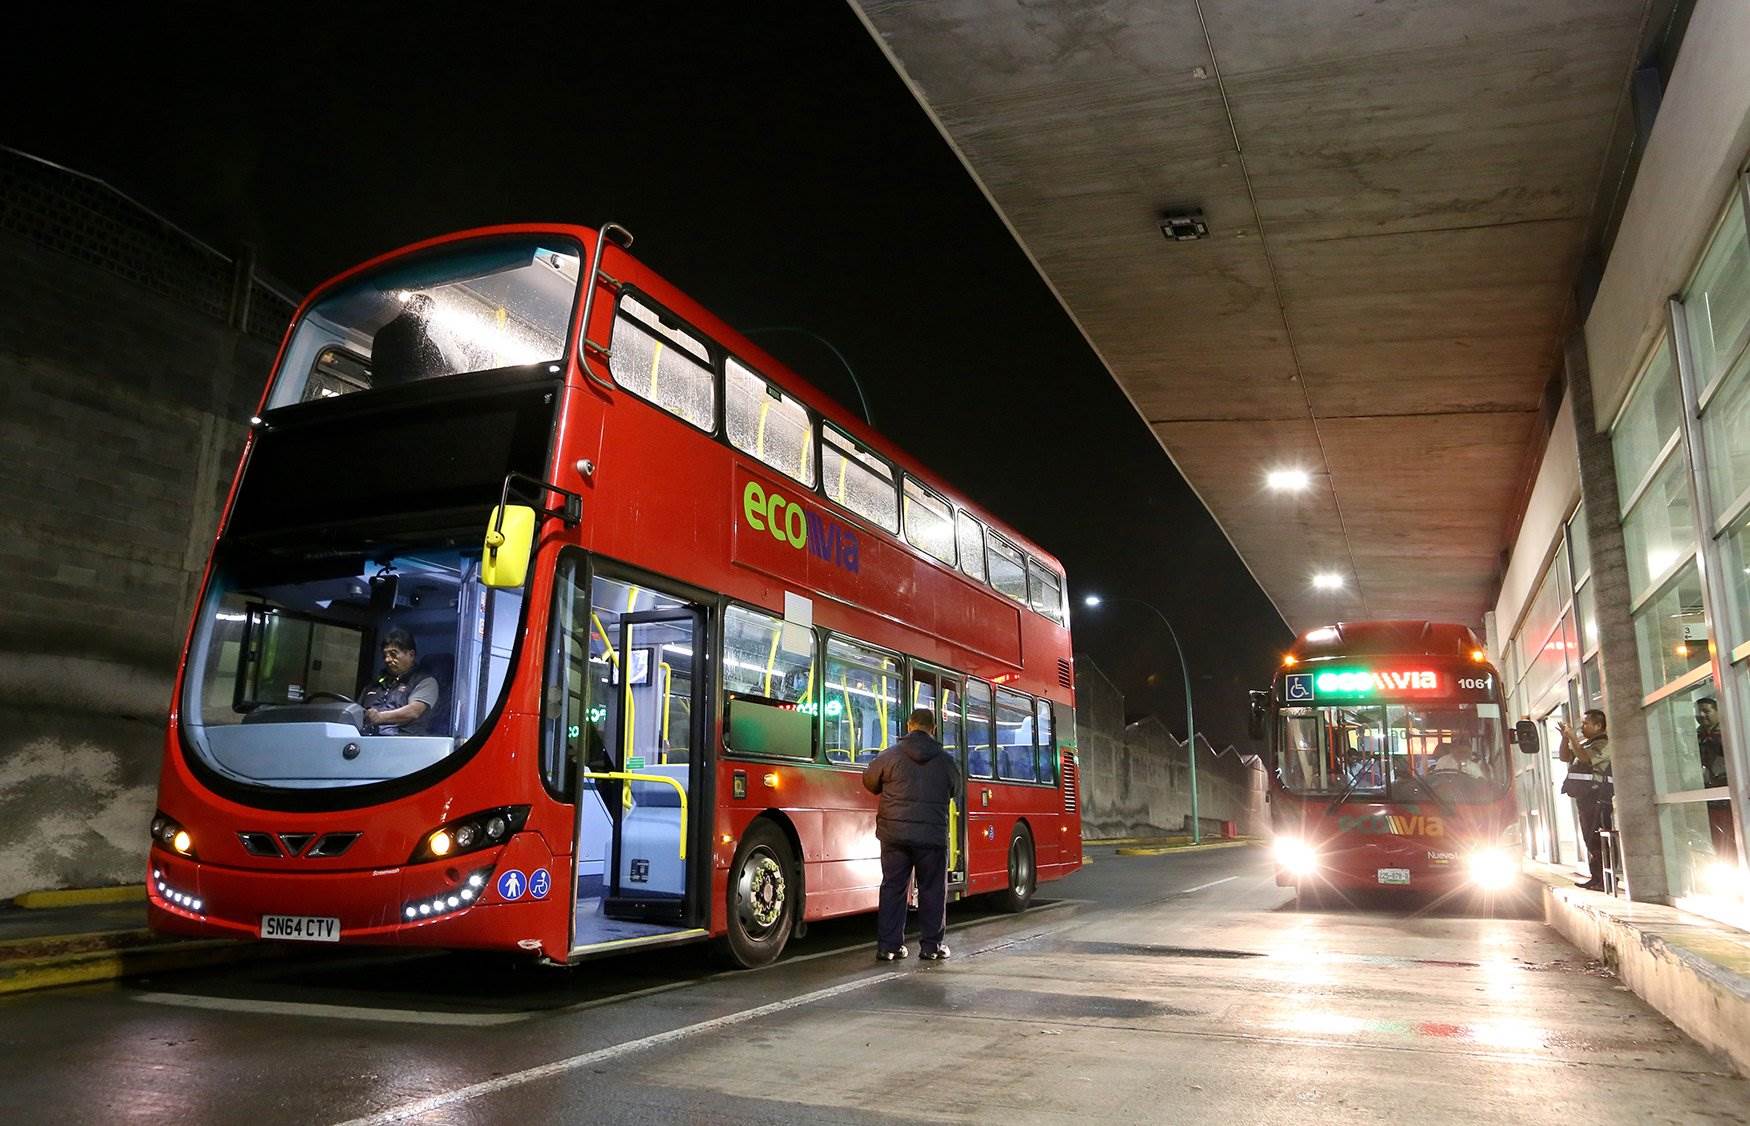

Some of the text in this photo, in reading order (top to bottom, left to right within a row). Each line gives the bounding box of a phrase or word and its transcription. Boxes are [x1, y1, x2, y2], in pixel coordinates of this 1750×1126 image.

[1457, 677, 1493, 690] 1061
[266, 917, 334, 938] SN64 CTV
